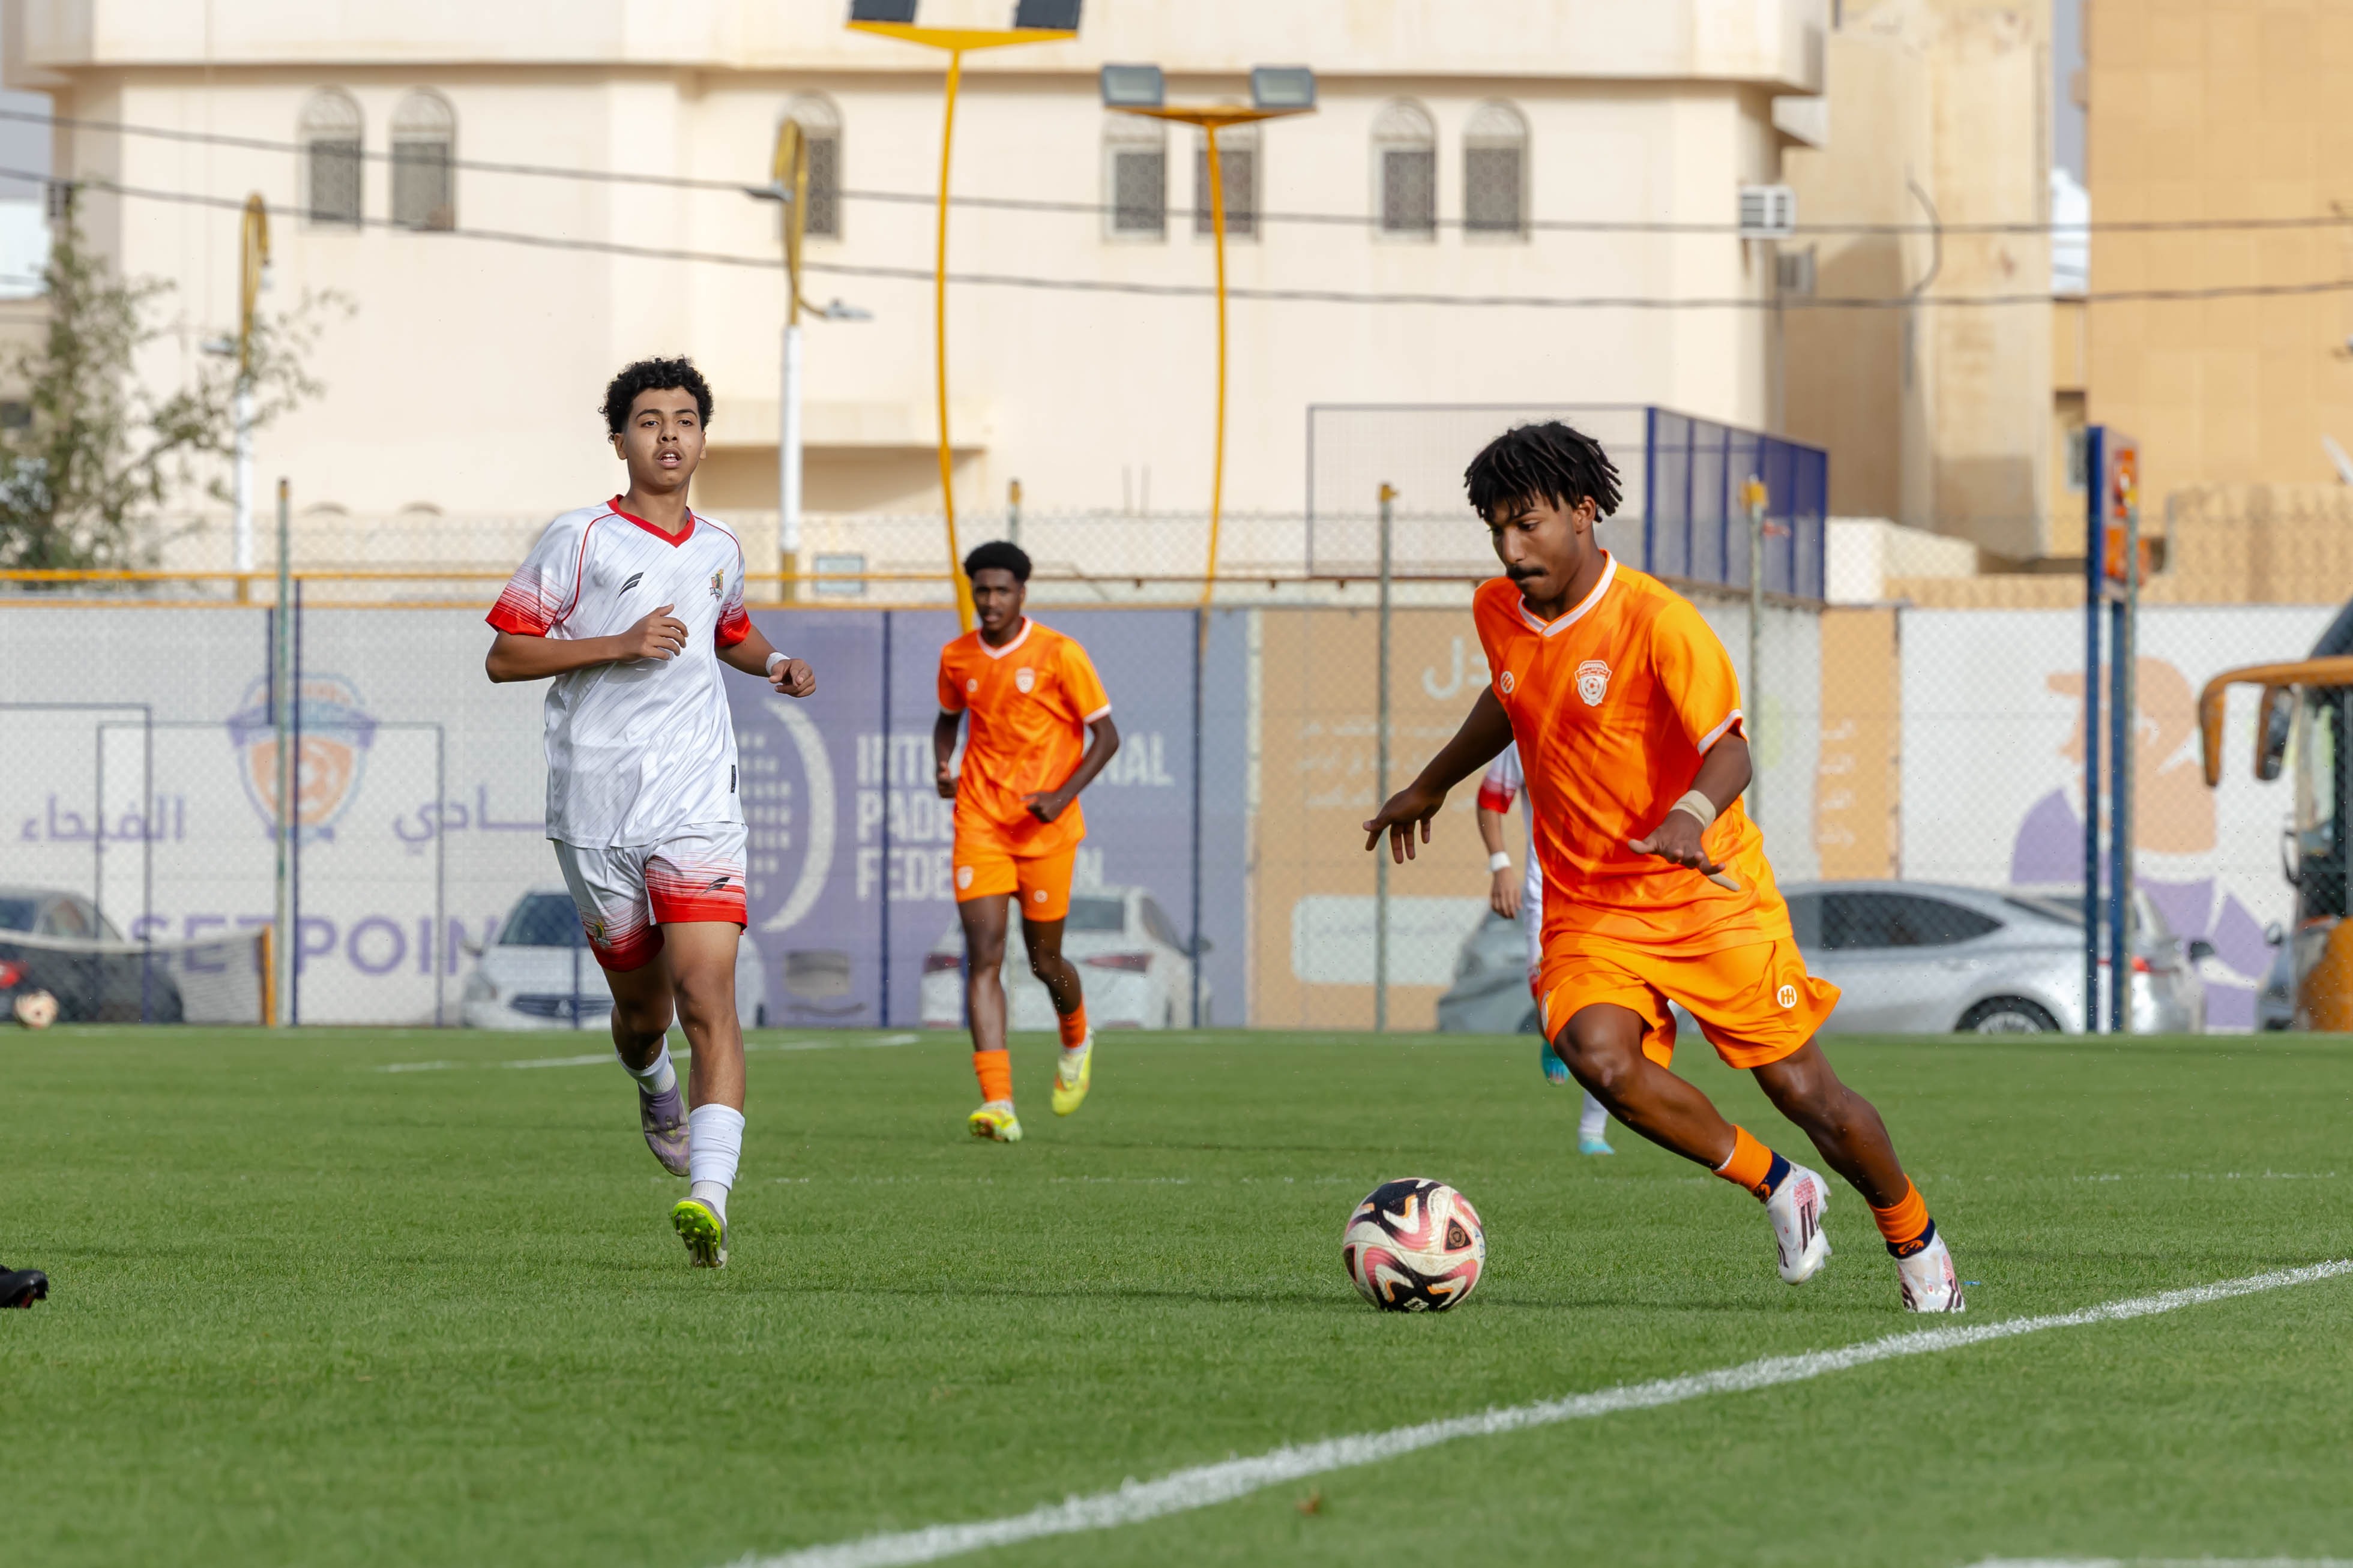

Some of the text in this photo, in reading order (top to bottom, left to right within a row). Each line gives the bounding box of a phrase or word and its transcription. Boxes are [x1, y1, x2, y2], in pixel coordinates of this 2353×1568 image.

[22, 783, 546, 855] ادي الفيحاء
[857, 789, 954, 841] PADE
[131, 916, 498, 976] SETPOIN
